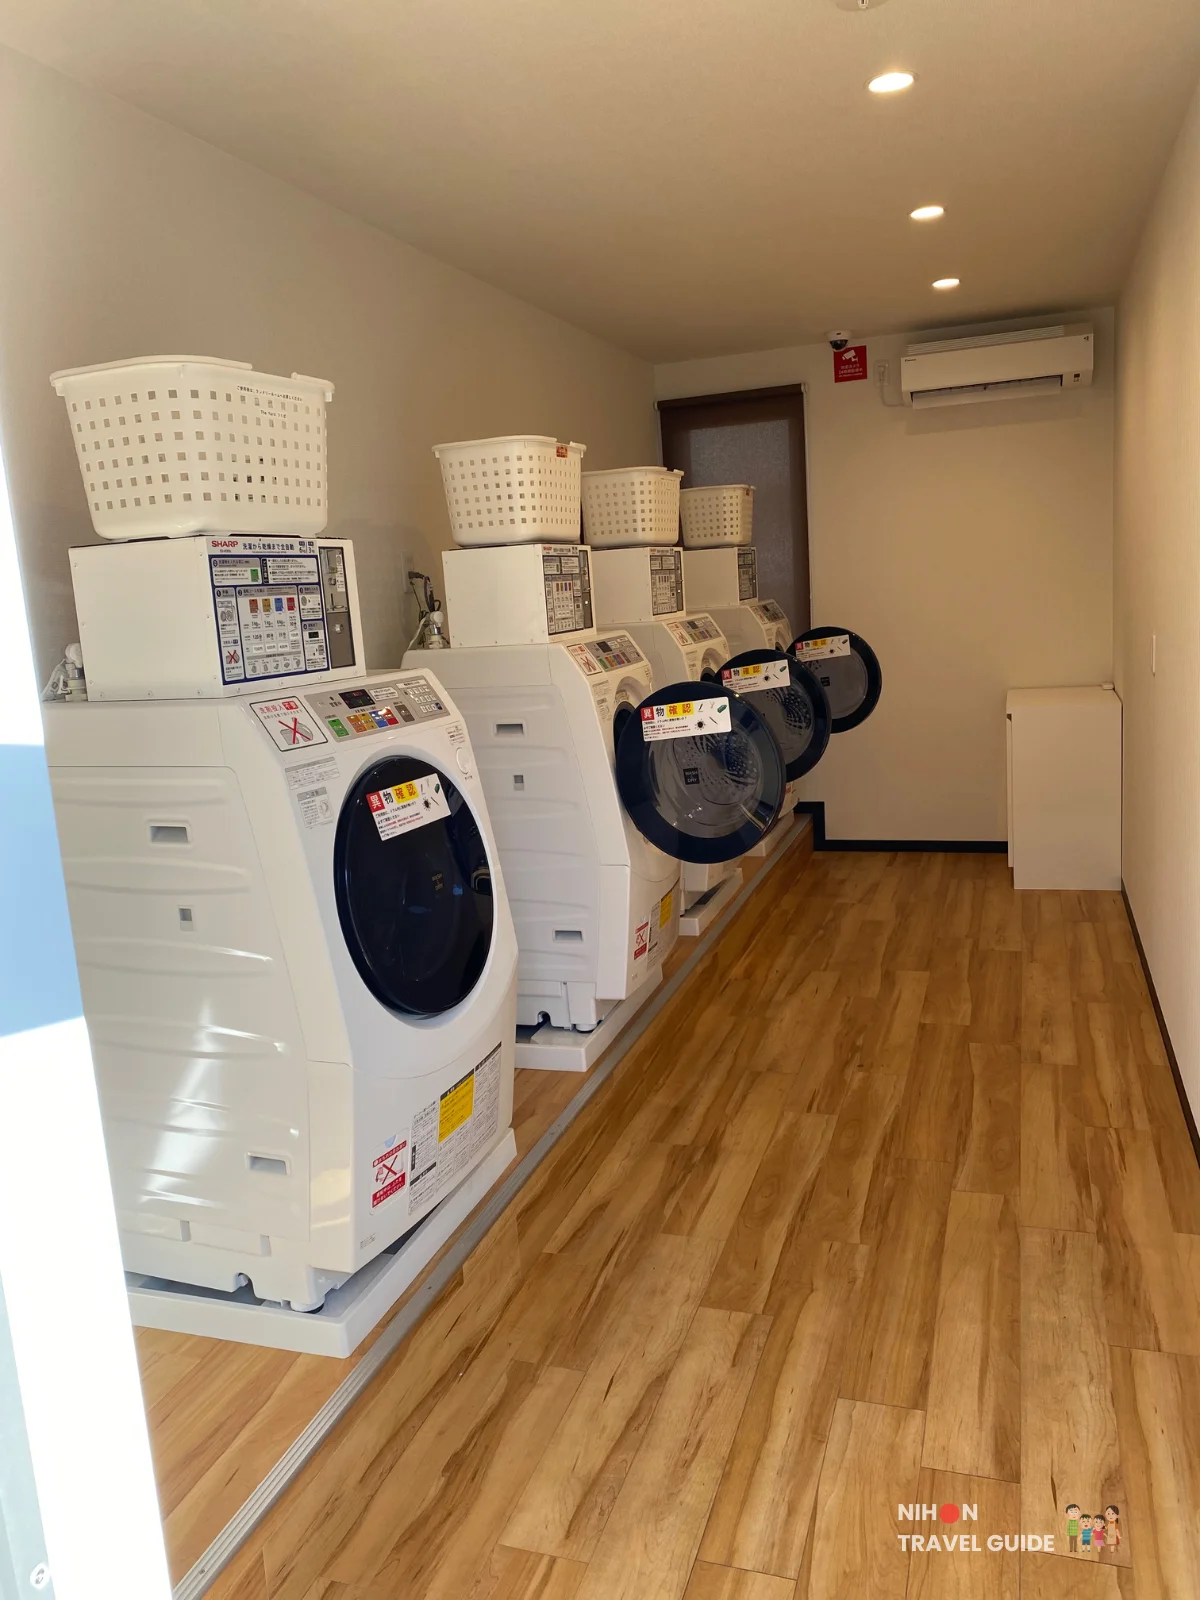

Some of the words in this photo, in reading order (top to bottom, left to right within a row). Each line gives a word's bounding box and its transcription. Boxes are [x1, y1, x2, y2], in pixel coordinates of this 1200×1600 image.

[211, 540, 239, 548] SHARP
[242, 542, 295, 551] 洗濯から乾燥まで全自動
[723, 665, 760, 678] 異物確認
[643, 703, 692, 719] 異物確認
[370, 783, 417, 809] 異物確認
